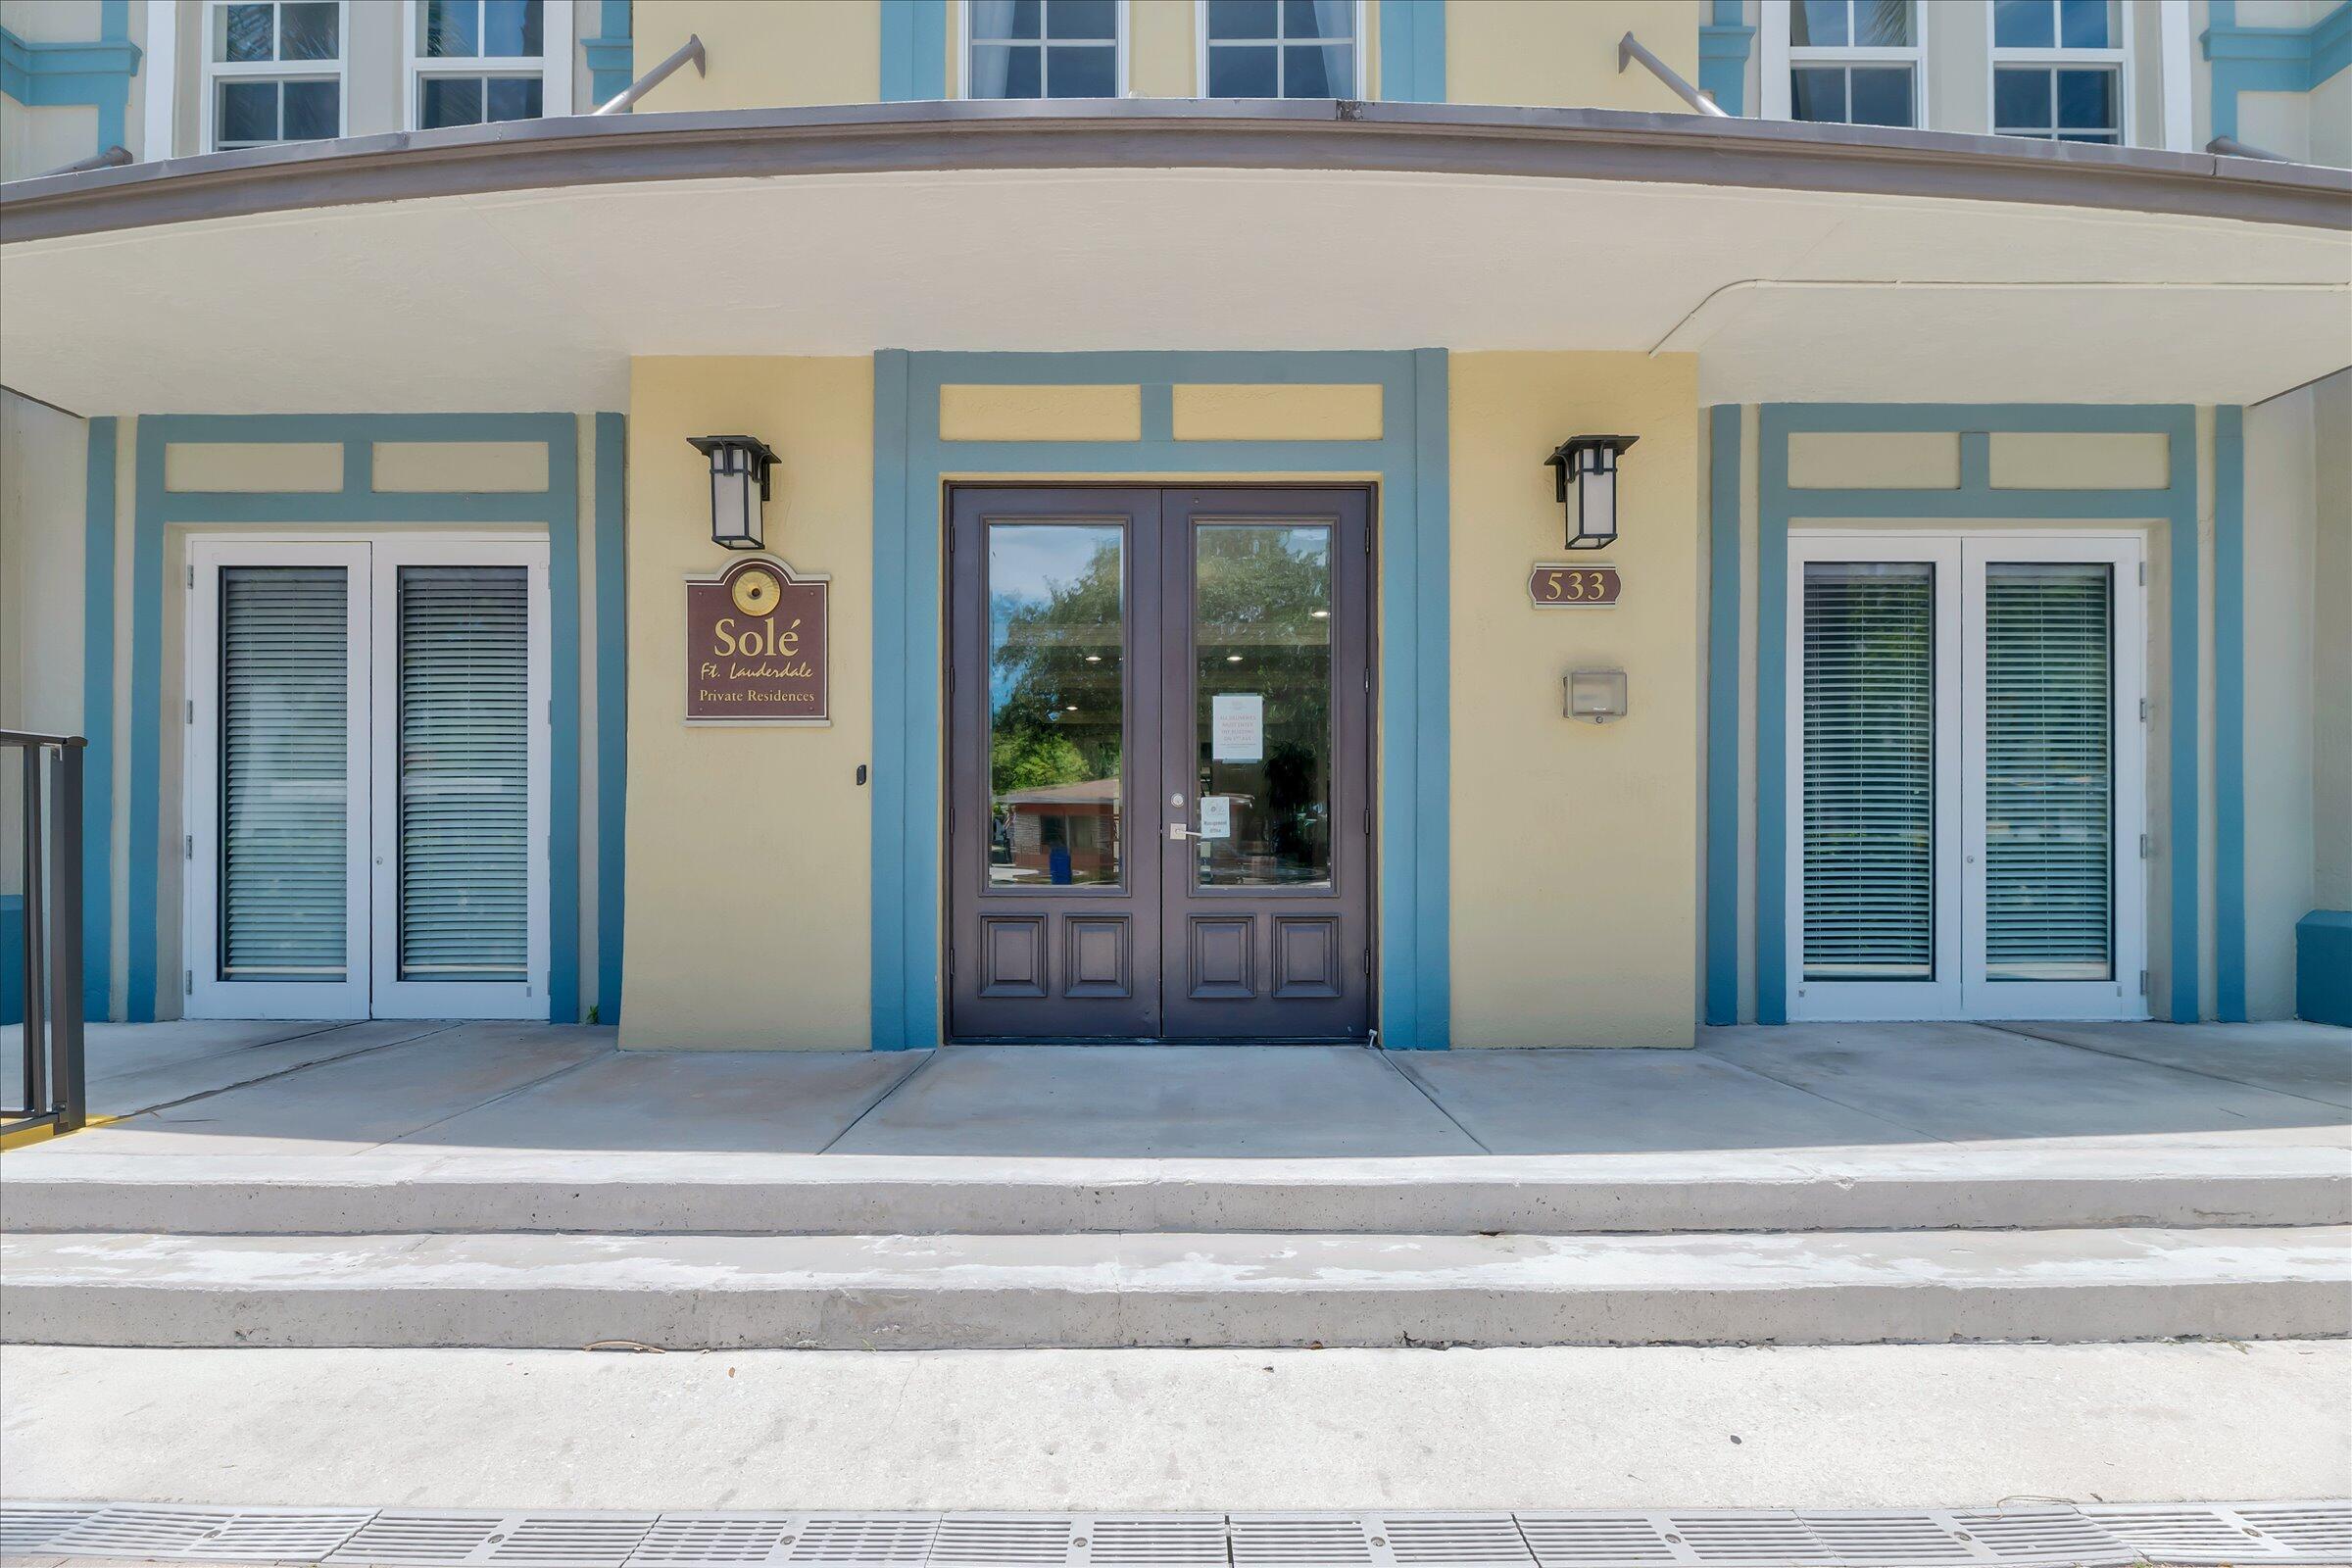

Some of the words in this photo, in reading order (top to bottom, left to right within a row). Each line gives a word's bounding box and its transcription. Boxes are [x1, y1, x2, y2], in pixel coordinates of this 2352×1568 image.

[1545, 571, 1605, 601] 533
[713, 616, 801, 658] Solé
[701, 662, 721, 680] Ft.
[729, 662, 813, 680] Lauderdale
[699, 689, 744, 702] Private
[748, 689, 814, 702] Residences
